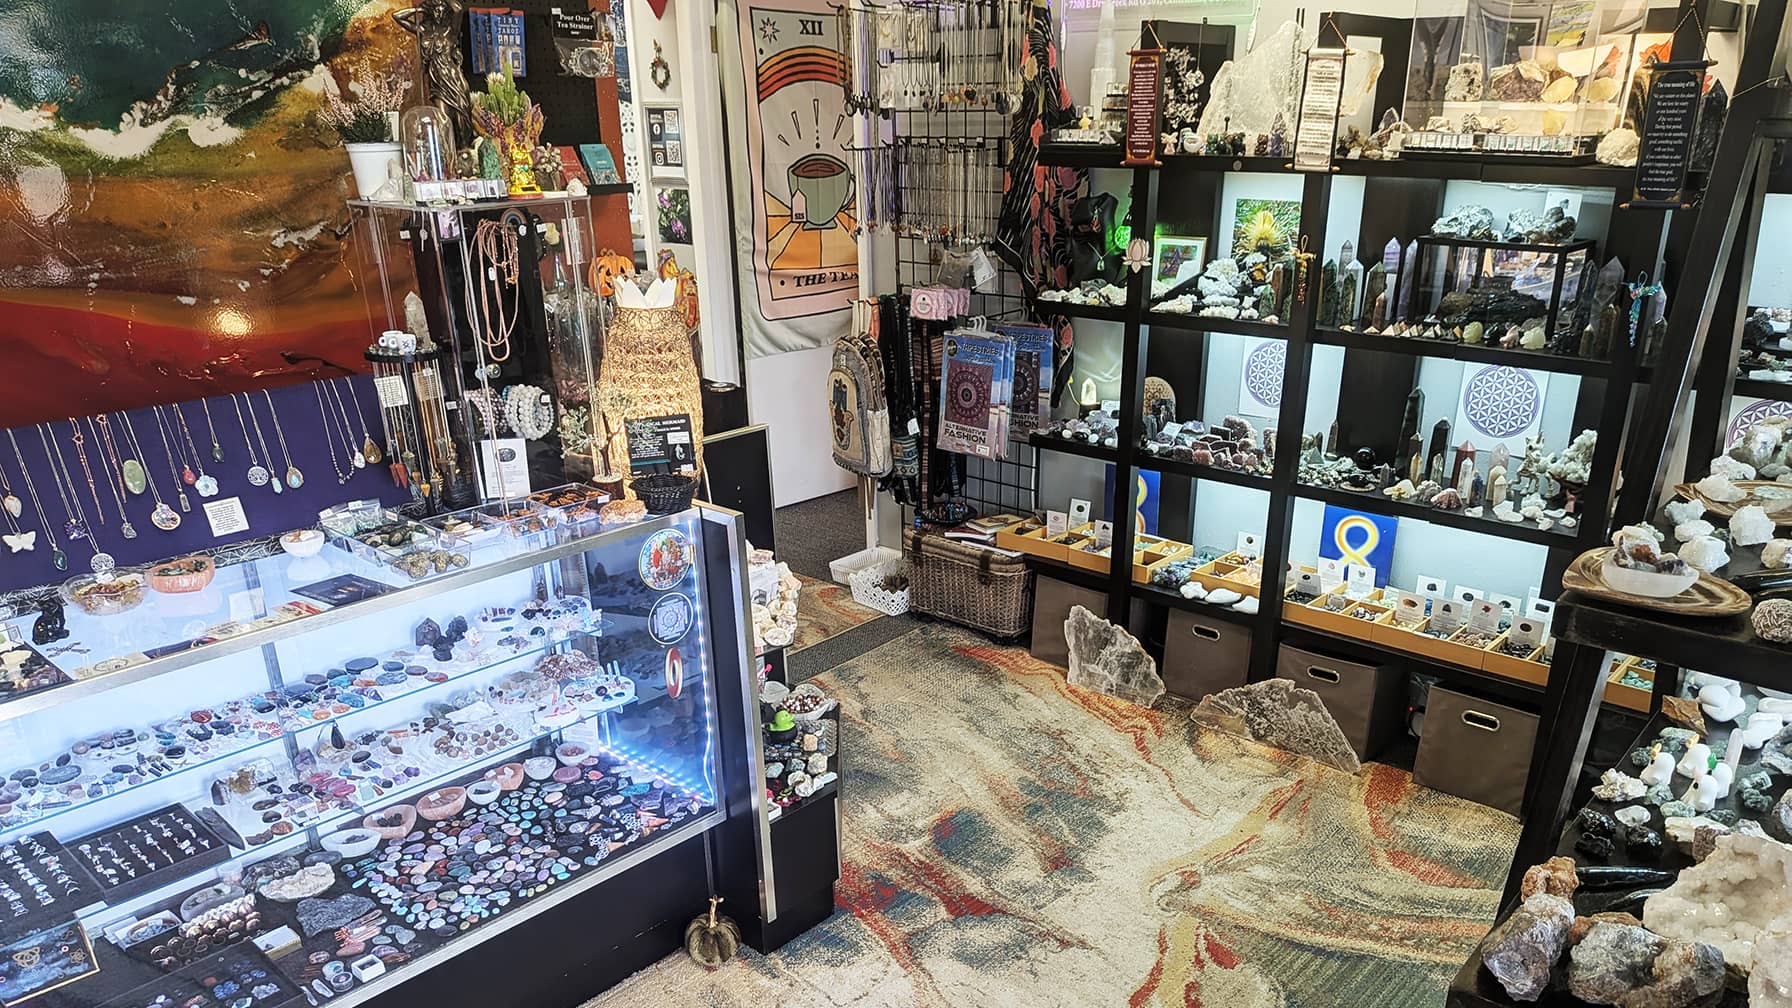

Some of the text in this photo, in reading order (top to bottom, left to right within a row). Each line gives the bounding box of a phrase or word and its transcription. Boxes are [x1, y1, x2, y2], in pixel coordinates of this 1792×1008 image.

[569, 21, 594, 30] Strainer
[799, 19, 824, 36] XII
[793, 271, 859, 288] THE TEA
[944, 421, 987, 437] ALTERNATIVE
[944, 428, 987, 445] FASHION
